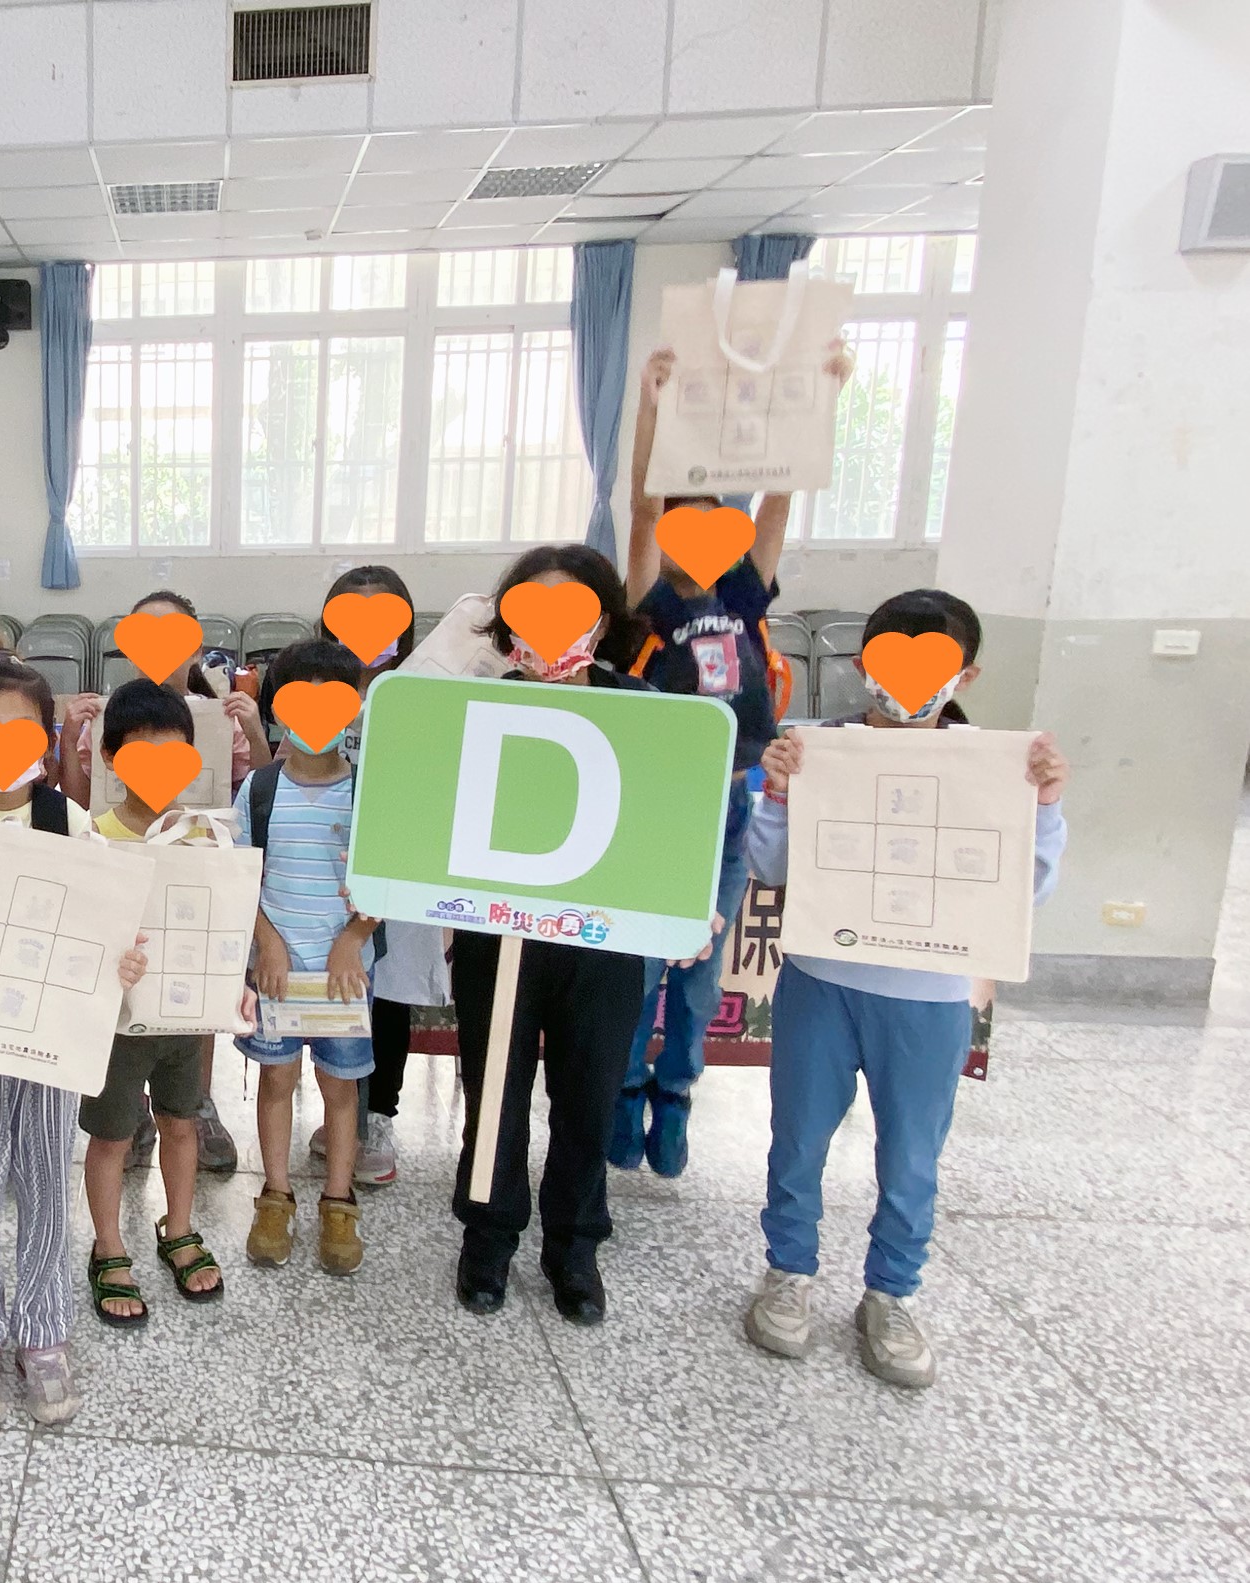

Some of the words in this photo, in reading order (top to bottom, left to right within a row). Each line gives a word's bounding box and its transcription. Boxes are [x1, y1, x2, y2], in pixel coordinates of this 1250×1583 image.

[448, 700, 622, 887] D
[489, 902, 607, 944] 防災小勇士
[732, 878, 786, 976] 保
